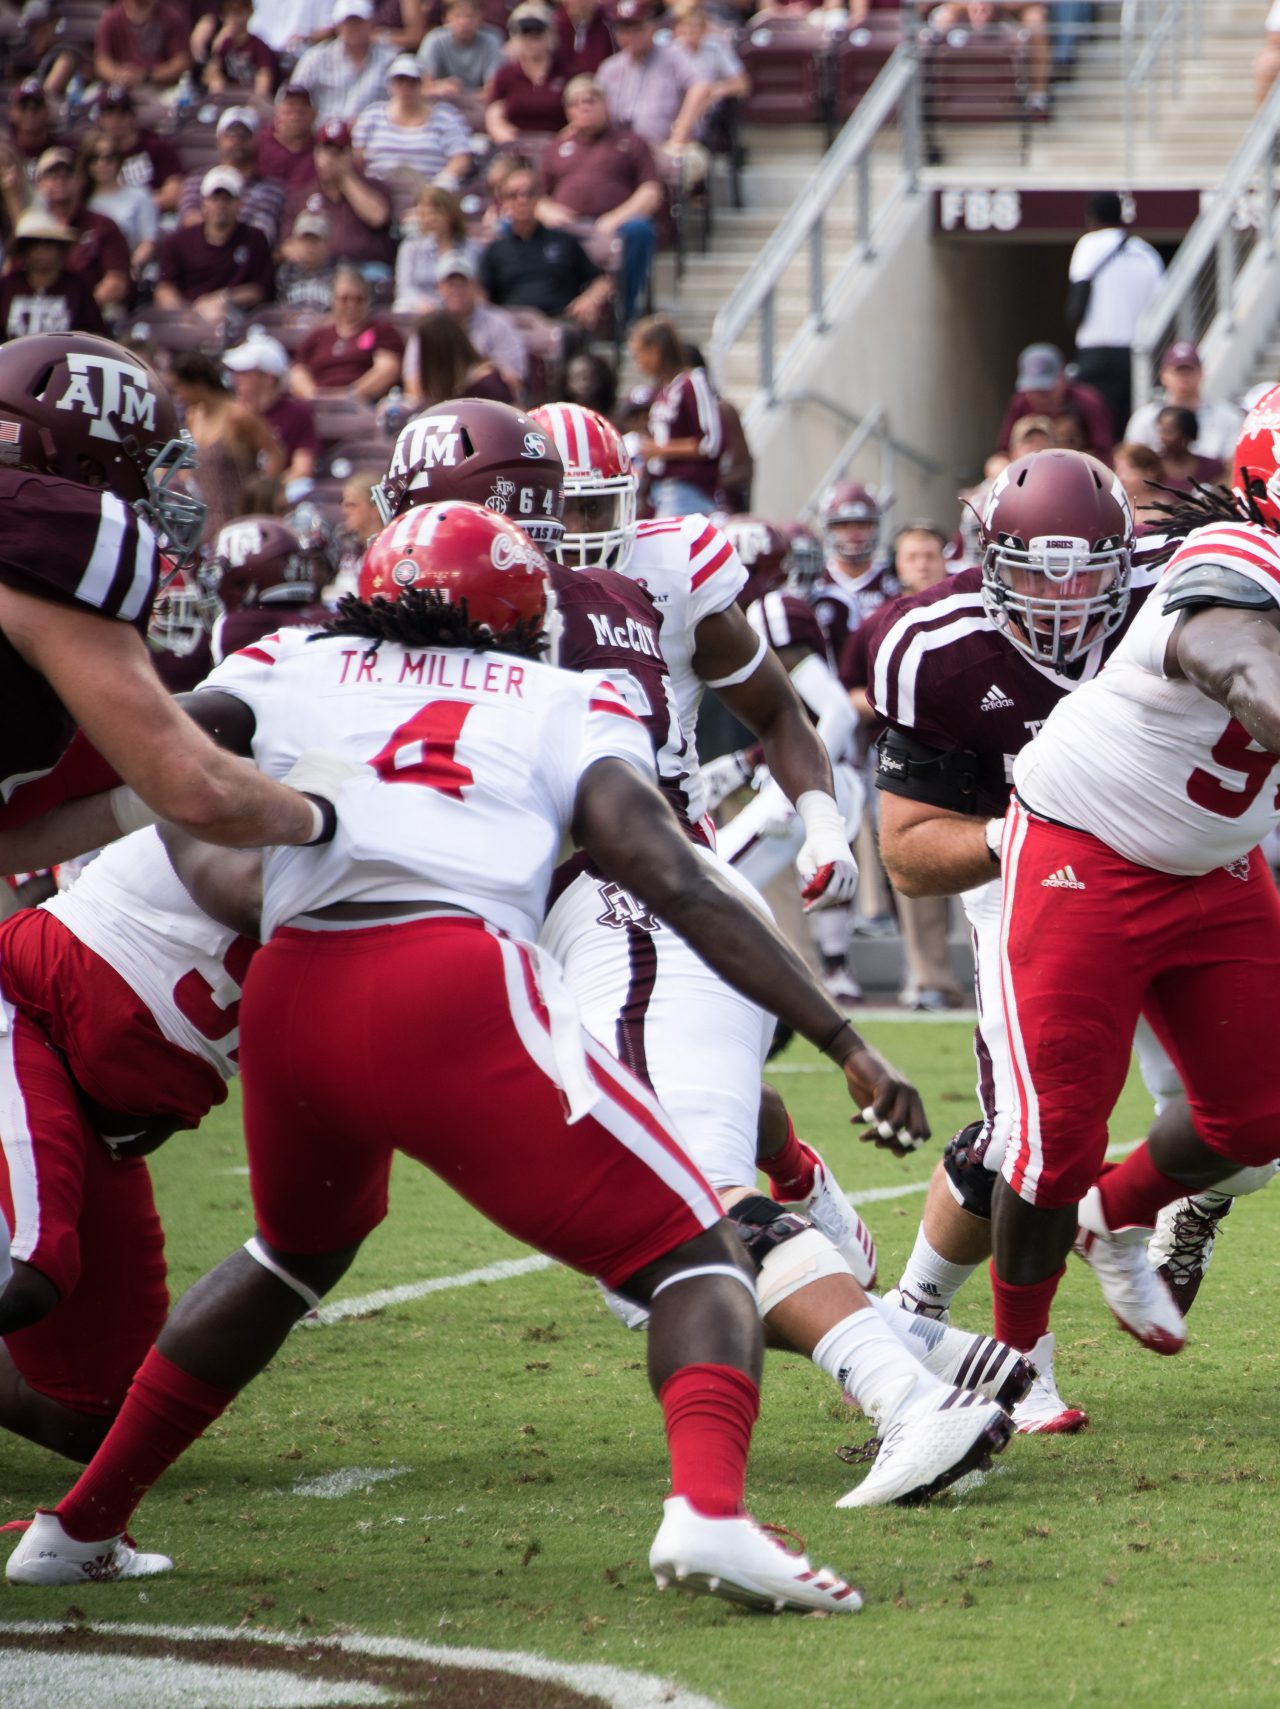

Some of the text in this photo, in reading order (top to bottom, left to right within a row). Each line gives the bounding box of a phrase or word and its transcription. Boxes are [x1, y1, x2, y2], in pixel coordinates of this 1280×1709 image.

[1045, 540, 1073, 549] AGGIES
[652, 594, 669, 603] ELT
[587, 613, 661, 659] McCOY
[339, 649, 525, 698] TR. MILLER
[980, 698, 1015, 712] adidas
[366, 699, 476, 803] 4
[1041, 878, 1086, 890] adidas
